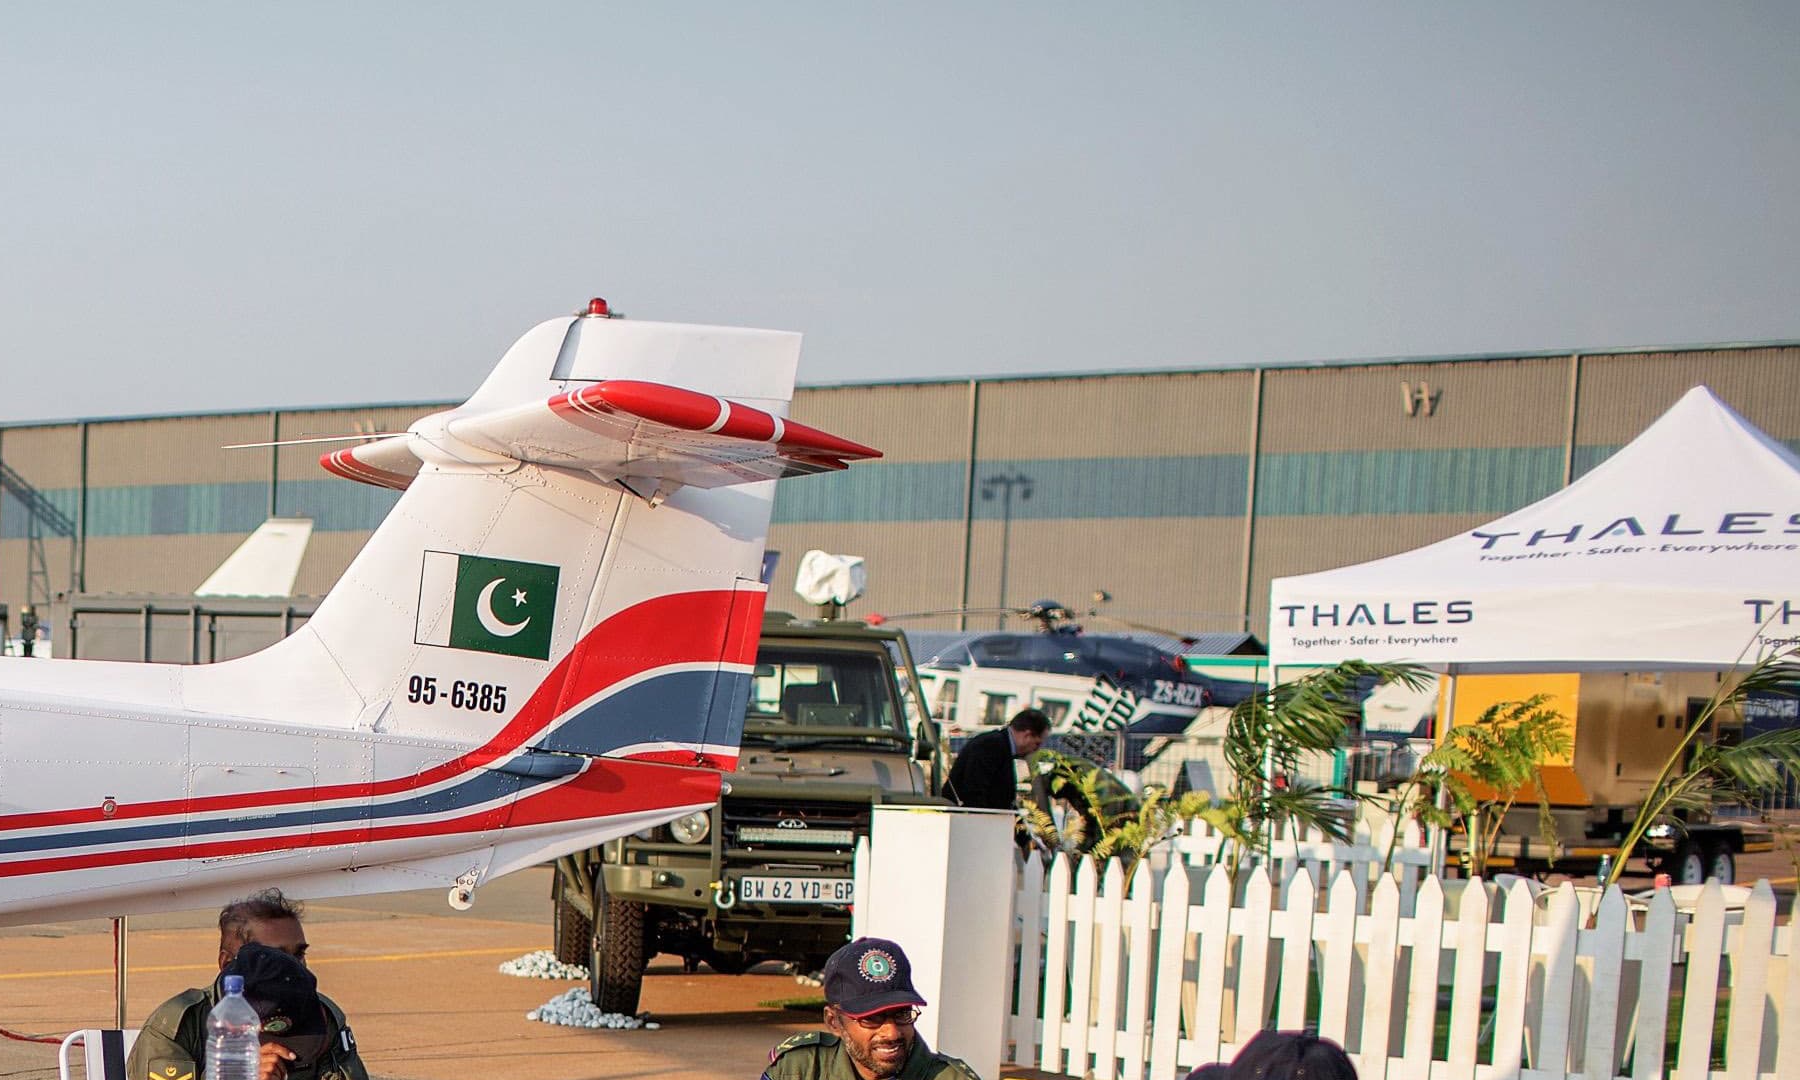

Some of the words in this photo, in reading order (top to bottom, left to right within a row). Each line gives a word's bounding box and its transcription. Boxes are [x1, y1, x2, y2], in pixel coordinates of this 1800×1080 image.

[1588, 543, 1642, 555] Safer
[1659, 541, 1798, 553] Everywhere
[1280, 601, 1473, 627] THALES
[1292, 636, 1342, 649] Together
[1350, 635, 1379, 646] Safer
[1388, 634, 1458, 648] Everywhere
[407, 675, 508, 714] 95-6385
[743, 880, 765, 898] BW
[772, 881, 793, 899] 62
[801, 881, 821, 899] YD
[834, 882, 854, 900] GP
